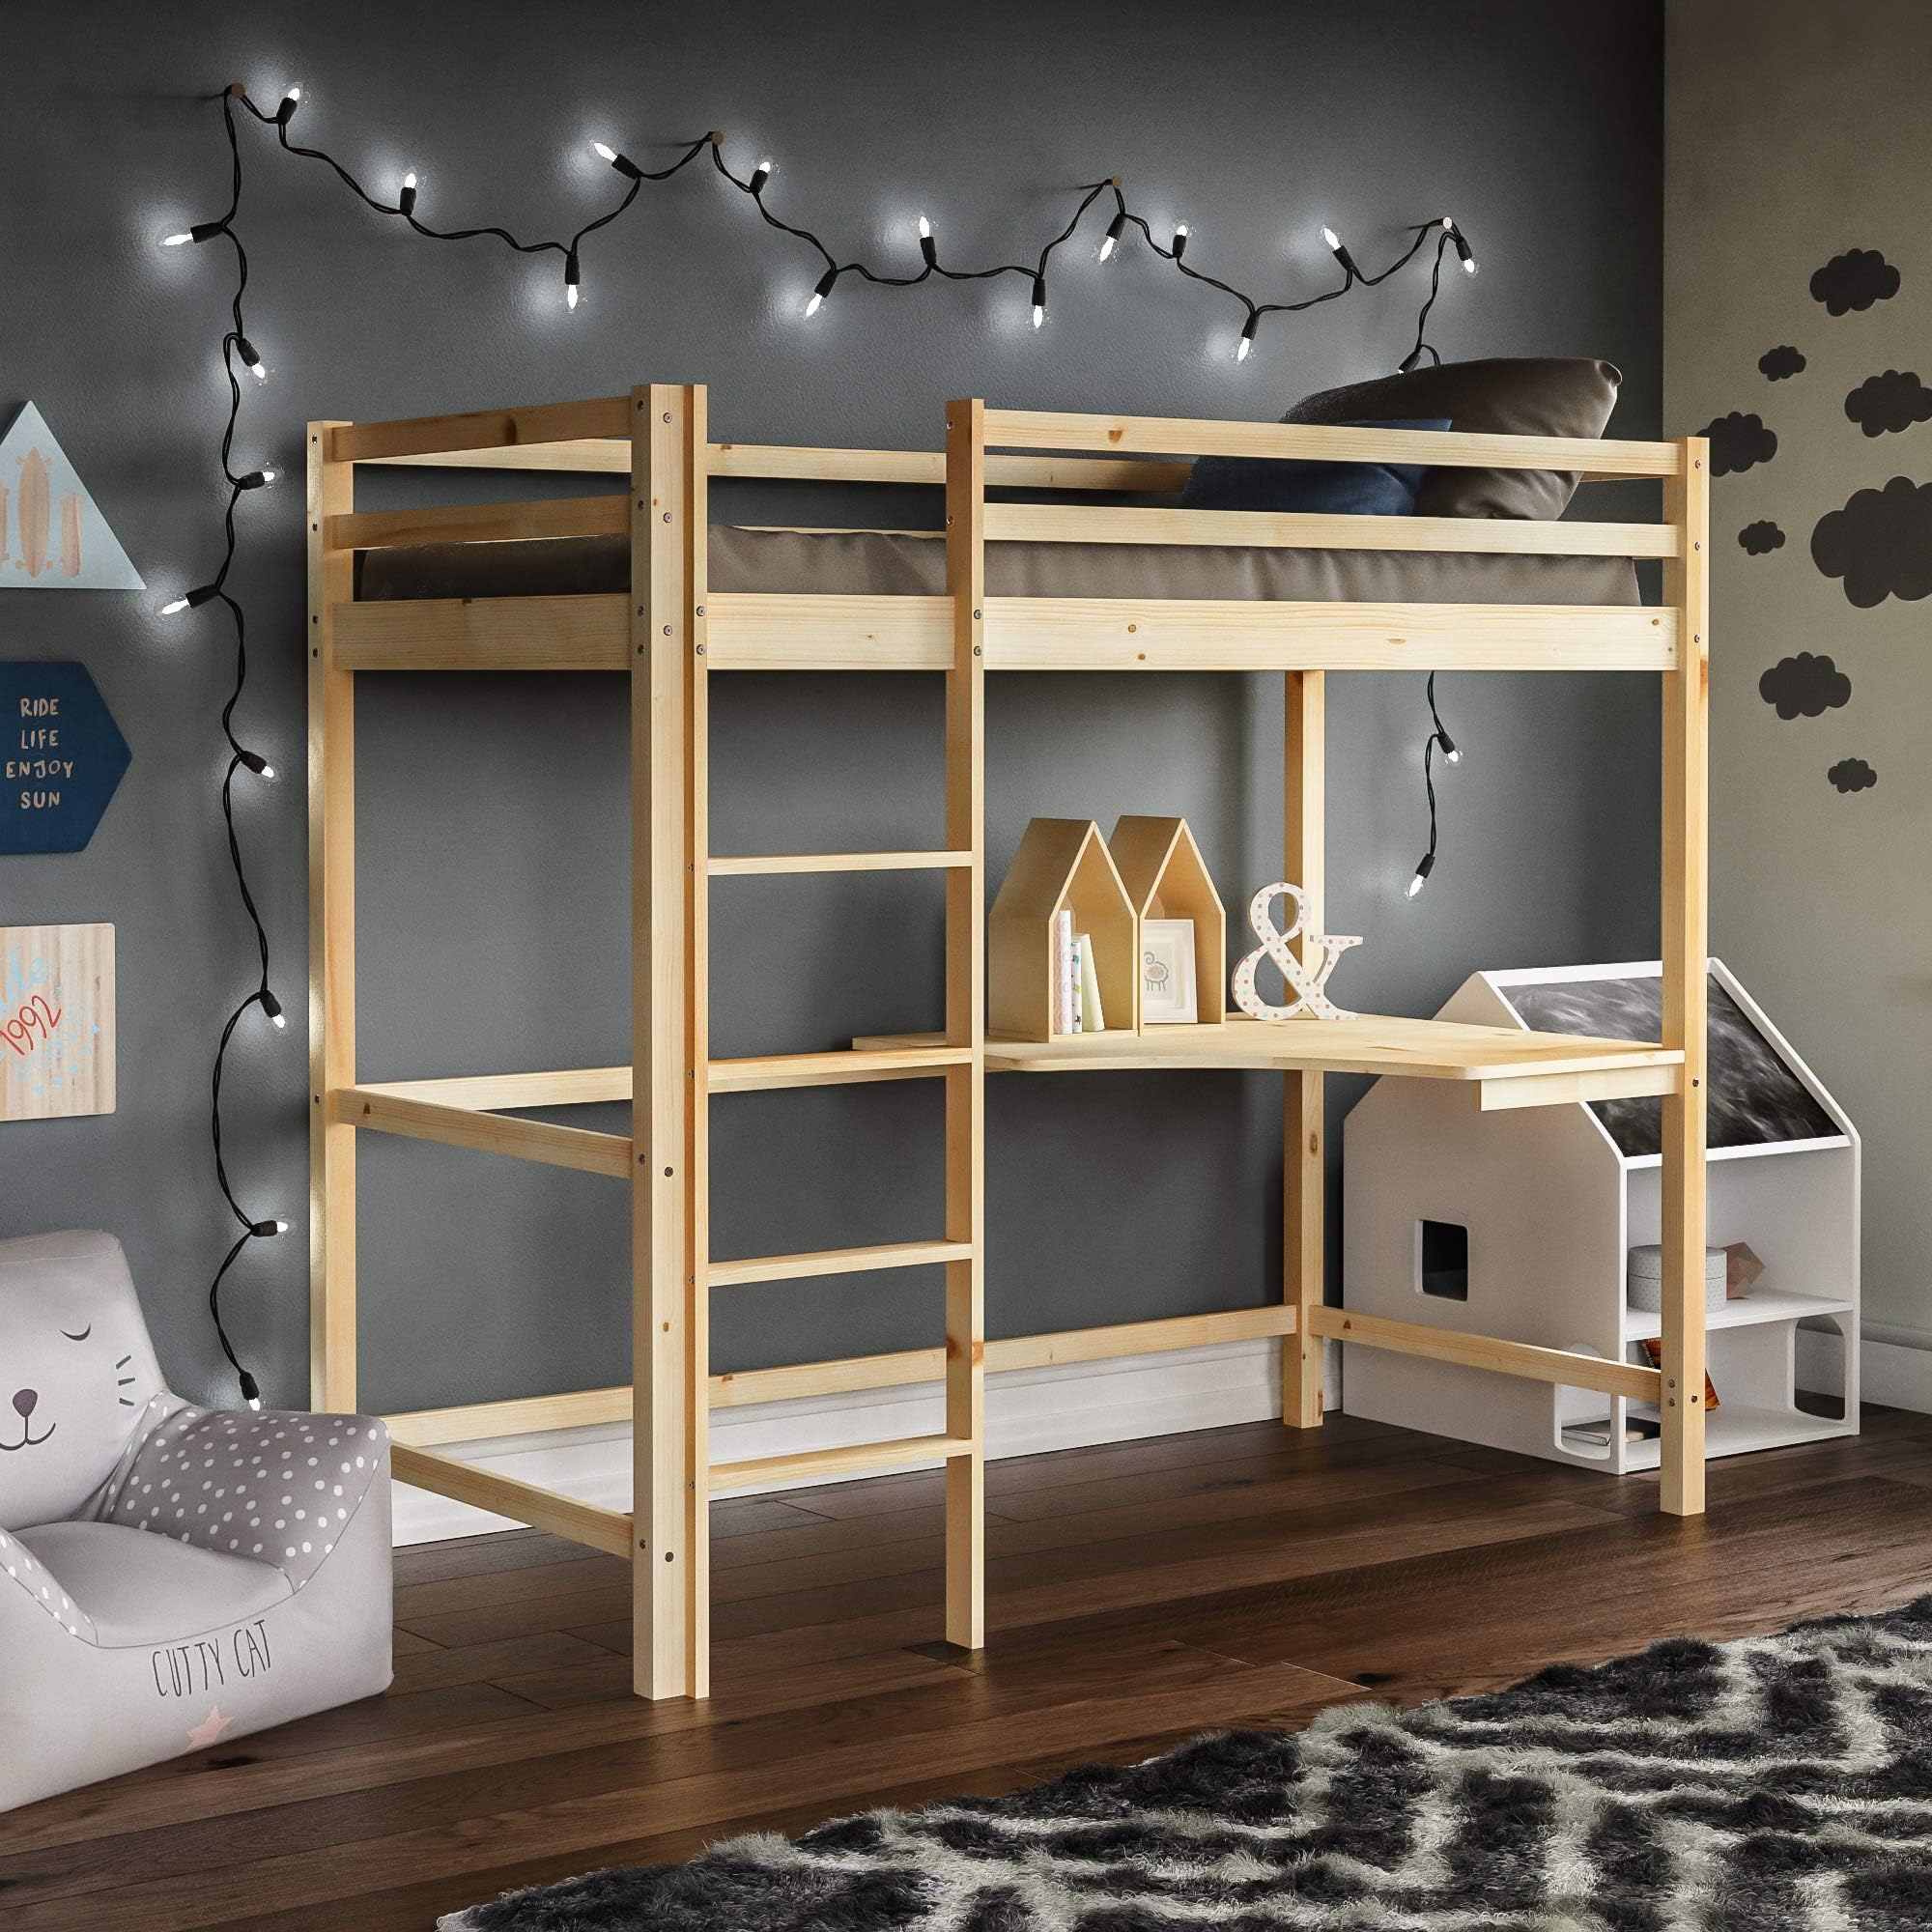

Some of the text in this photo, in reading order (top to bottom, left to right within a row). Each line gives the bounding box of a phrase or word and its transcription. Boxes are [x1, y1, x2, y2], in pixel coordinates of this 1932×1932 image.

[20, 697, 60, 718] RIDE
[20, 728, 60, 750] LIFE
[6, 759, 73, 779] ENJOY
[20, 791, 61, 810] SUN
[0, 994, 62, 1056] 1992
[152, 1619, 270, 1697] CUTTY CAT
